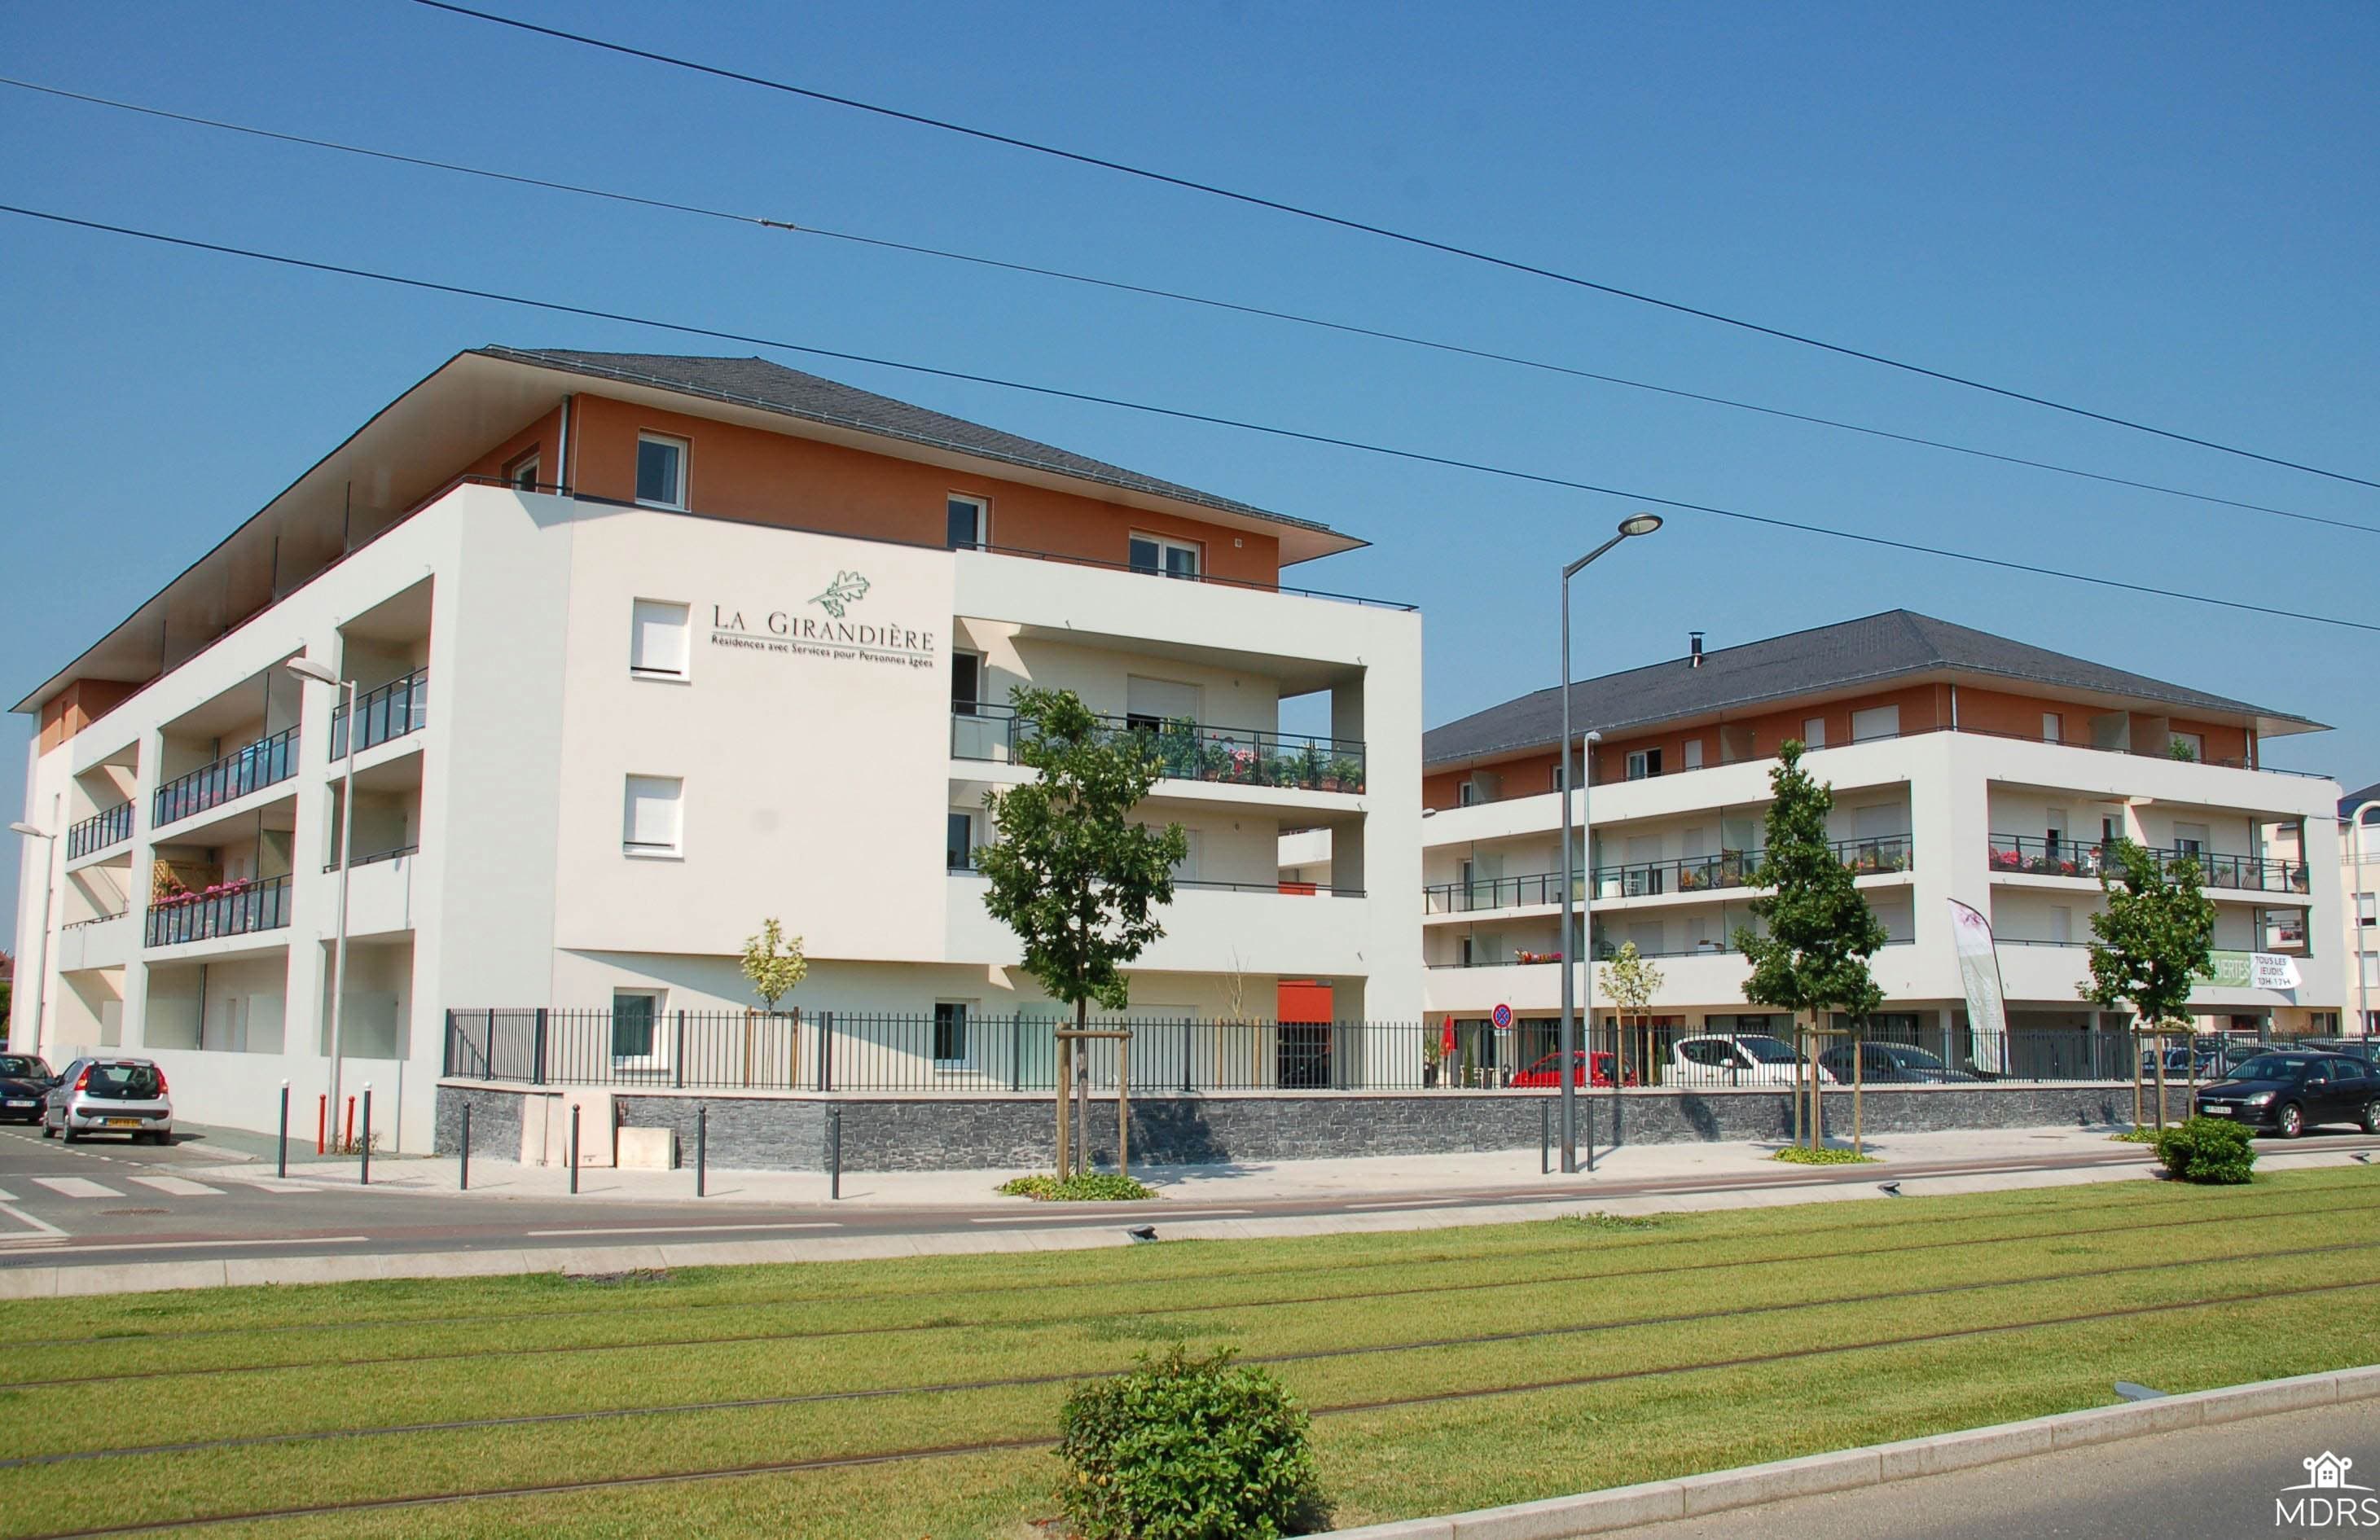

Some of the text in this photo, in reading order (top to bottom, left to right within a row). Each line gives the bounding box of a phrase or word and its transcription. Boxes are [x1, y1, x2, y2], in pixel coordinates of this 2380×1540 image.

[714, 604, 934, 652] LA GIRANDIÈRE
[711, 634, 765, 651] Résidences
[768, 642, 788, 653] avec
[792, 643, 831, 658] Services
[833, 649, 855, 661] pour
[859, 651, 906, 666] Personnes
[2255, 956, 2287, 966] TOUS LES
